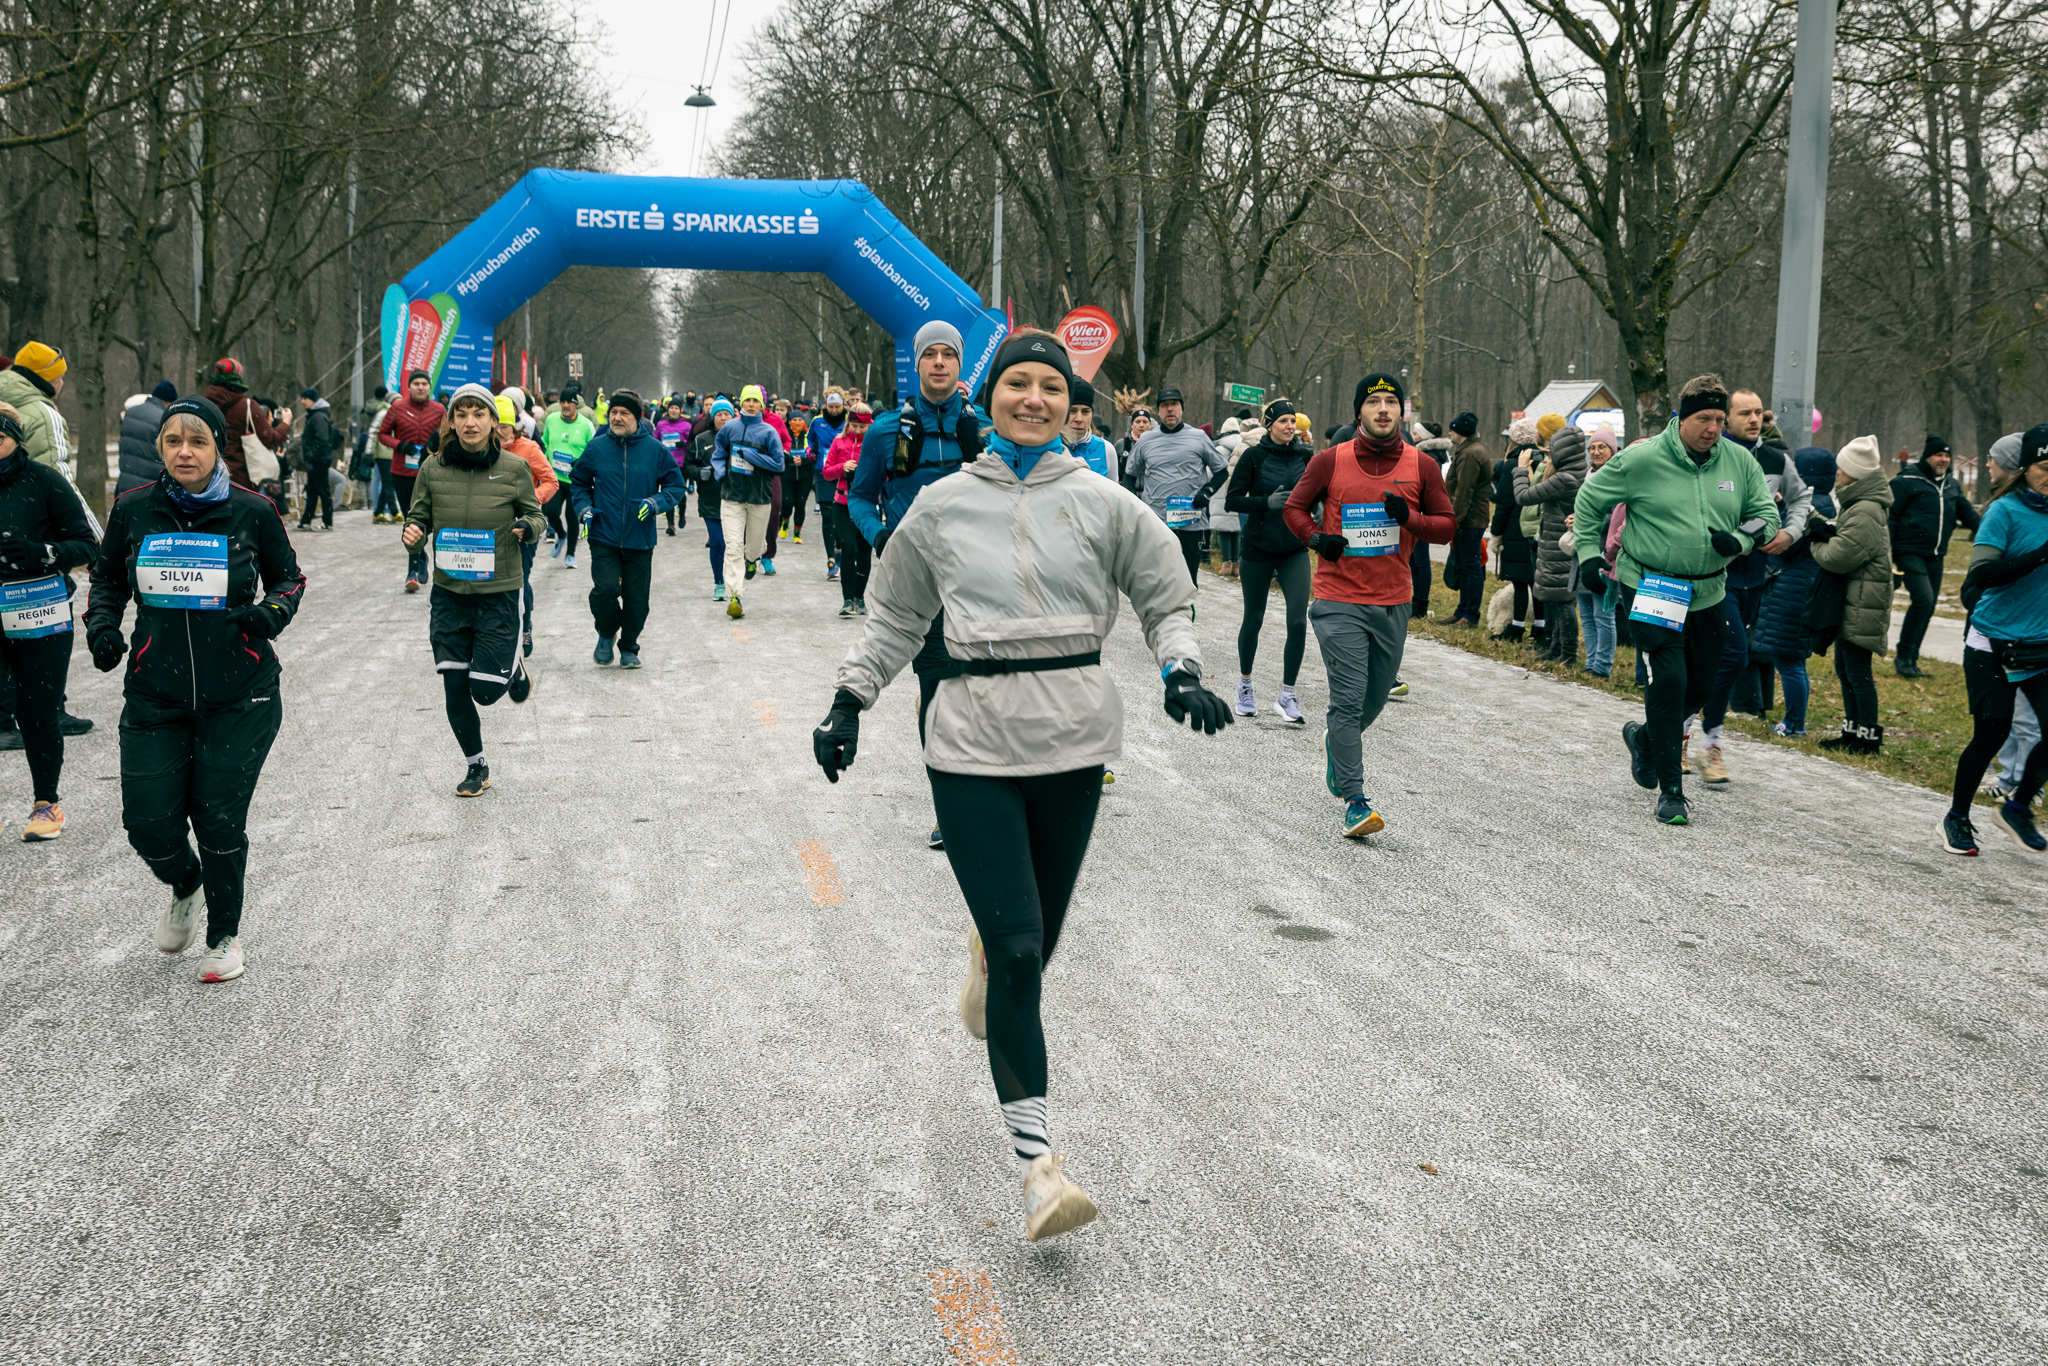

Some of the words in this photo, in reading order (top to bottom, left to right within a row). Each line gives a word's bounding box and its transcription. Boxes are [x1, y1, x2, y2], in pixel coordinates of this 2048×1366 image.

[576, 208, 641, 230] ERSTE
[672, 212, 796, 235] SPARKASSE
[456, 226, 541, 297] #glaubandich
[853, 237, 931, 311] #glaubandich
[1069, 324, 1103, 337] Wien
[1357, 529, 1387, 538] JONAS
[149, 538, 167, 546] ERSTE
[174, 539, 212, 547] SPARKASSE
[160, 570, 204, 582] SILVIA
[28, 583, 54, 593] SPARKASSE
[172, 585, 190, 593] 606
[1660, 580, 1684, 591] SPARKASSE
[18, 607, 56, 620] REGINE
